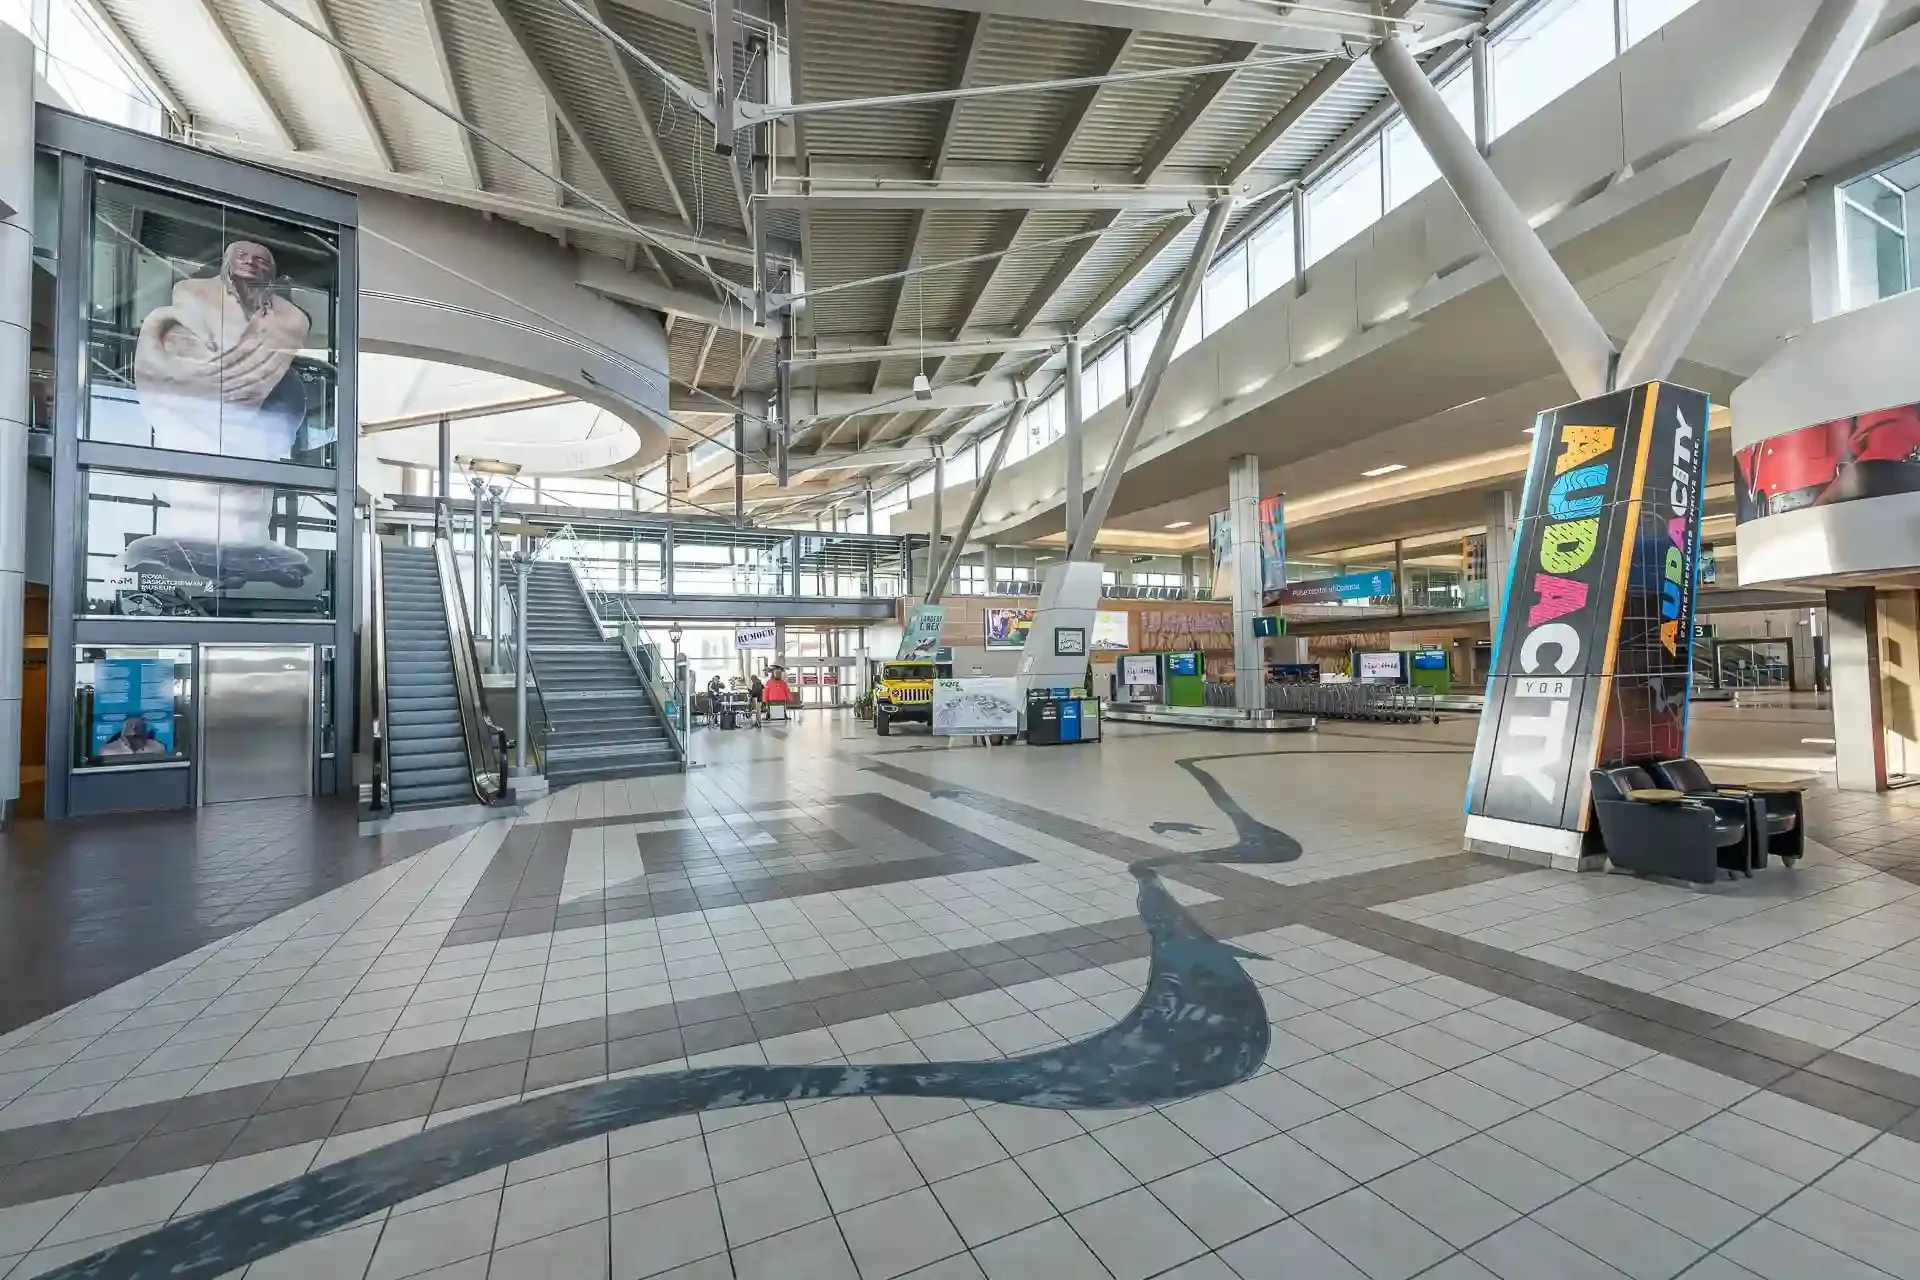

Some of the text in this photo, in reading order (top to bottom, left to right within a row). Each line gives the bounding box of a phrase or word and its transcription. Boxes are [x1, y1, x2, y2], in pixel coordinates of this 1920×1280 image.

[1687, 480, 1697, 524] THRIVE
[1660, 405, 1693, 658] AUDACITY
[141, 584, 176, 592] MUSEUM
[920, 615, 943, 623] LARGEST
[1502, 425, 1617, 803] AUDACITY
[1262, 620, 1269, 635] 1
[1695, 626, 1704, 637] 3
[737, 629, 775, 644] RUMOUR
